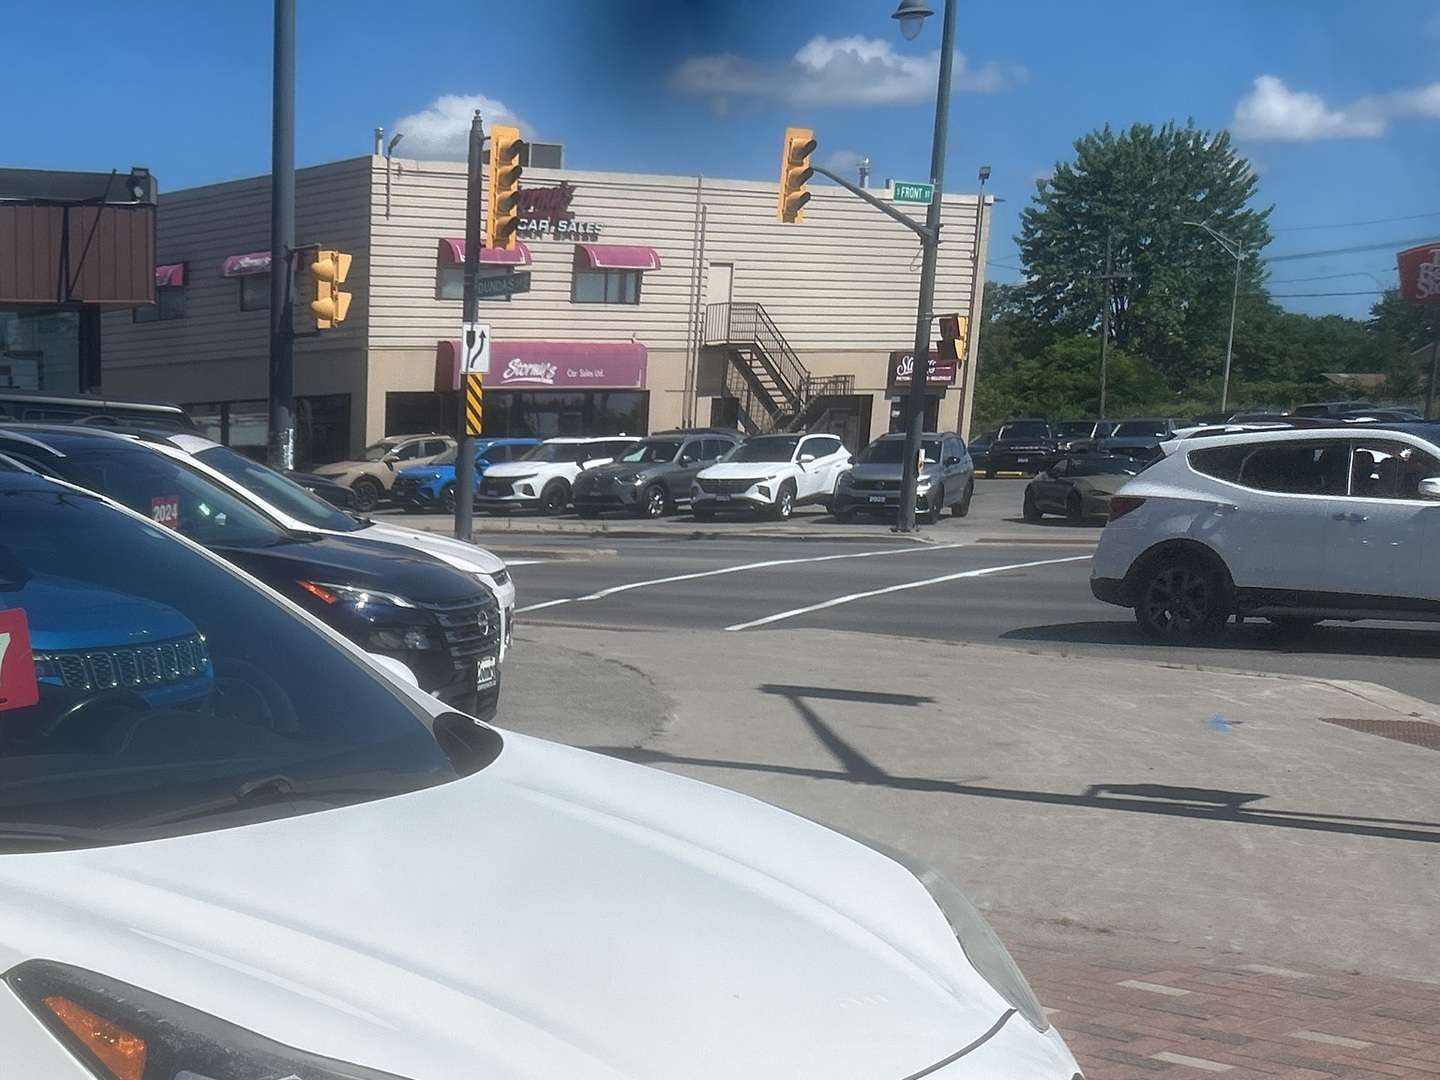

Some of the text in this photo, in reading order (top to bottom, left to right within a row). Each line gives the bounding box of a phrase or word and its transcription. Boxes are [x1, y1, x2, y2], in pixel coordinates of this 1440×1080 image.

[901, 186, 922, 199] FRONT
[517, 218, 603, 234] CAR SALES
[153, 504, 178, 522] 2024
